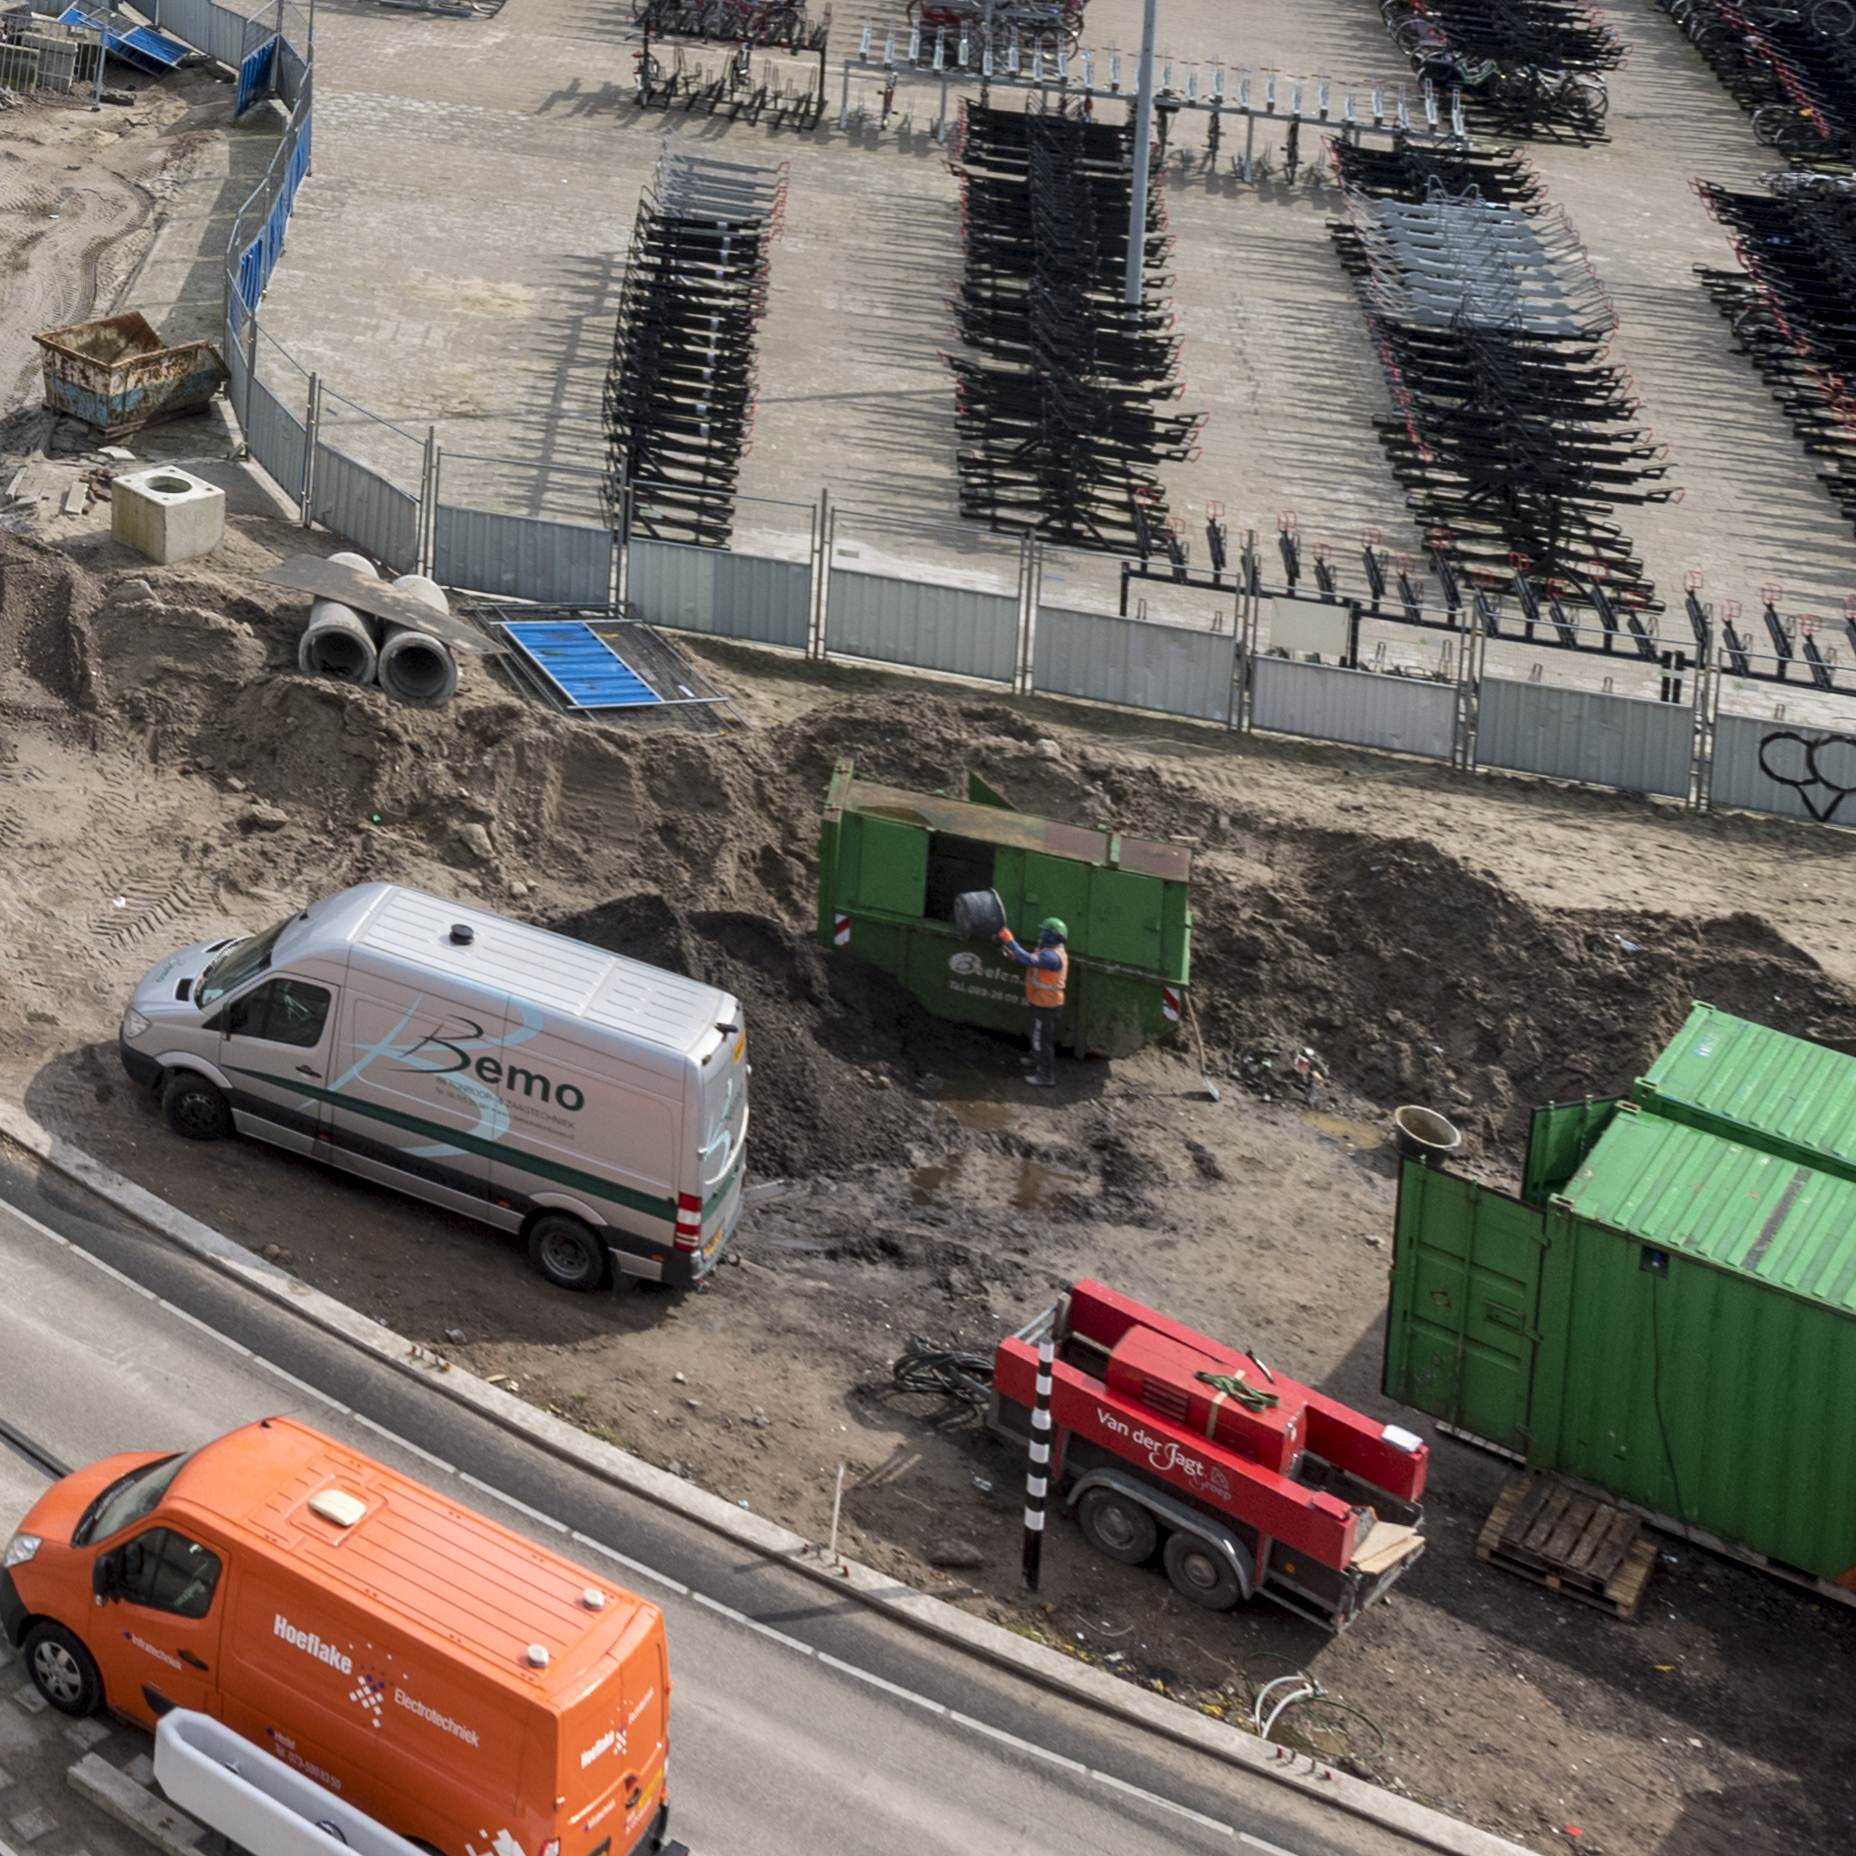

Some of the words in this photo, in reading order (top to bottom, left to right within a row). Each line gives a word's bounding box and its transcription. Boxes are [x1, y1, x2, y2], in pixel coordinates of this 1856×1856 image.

[386, 1014, 585, 1112] Bemo
[1097, 1407, 1129, 1436] Van
[1132, 1430, 1163, 1452] der
[1149, 1443, 1204, 1477] Jagt
[273, 1612, 353, 1676] Hoeflake
[394, 1687, 481, 1748] Electrotechniek
